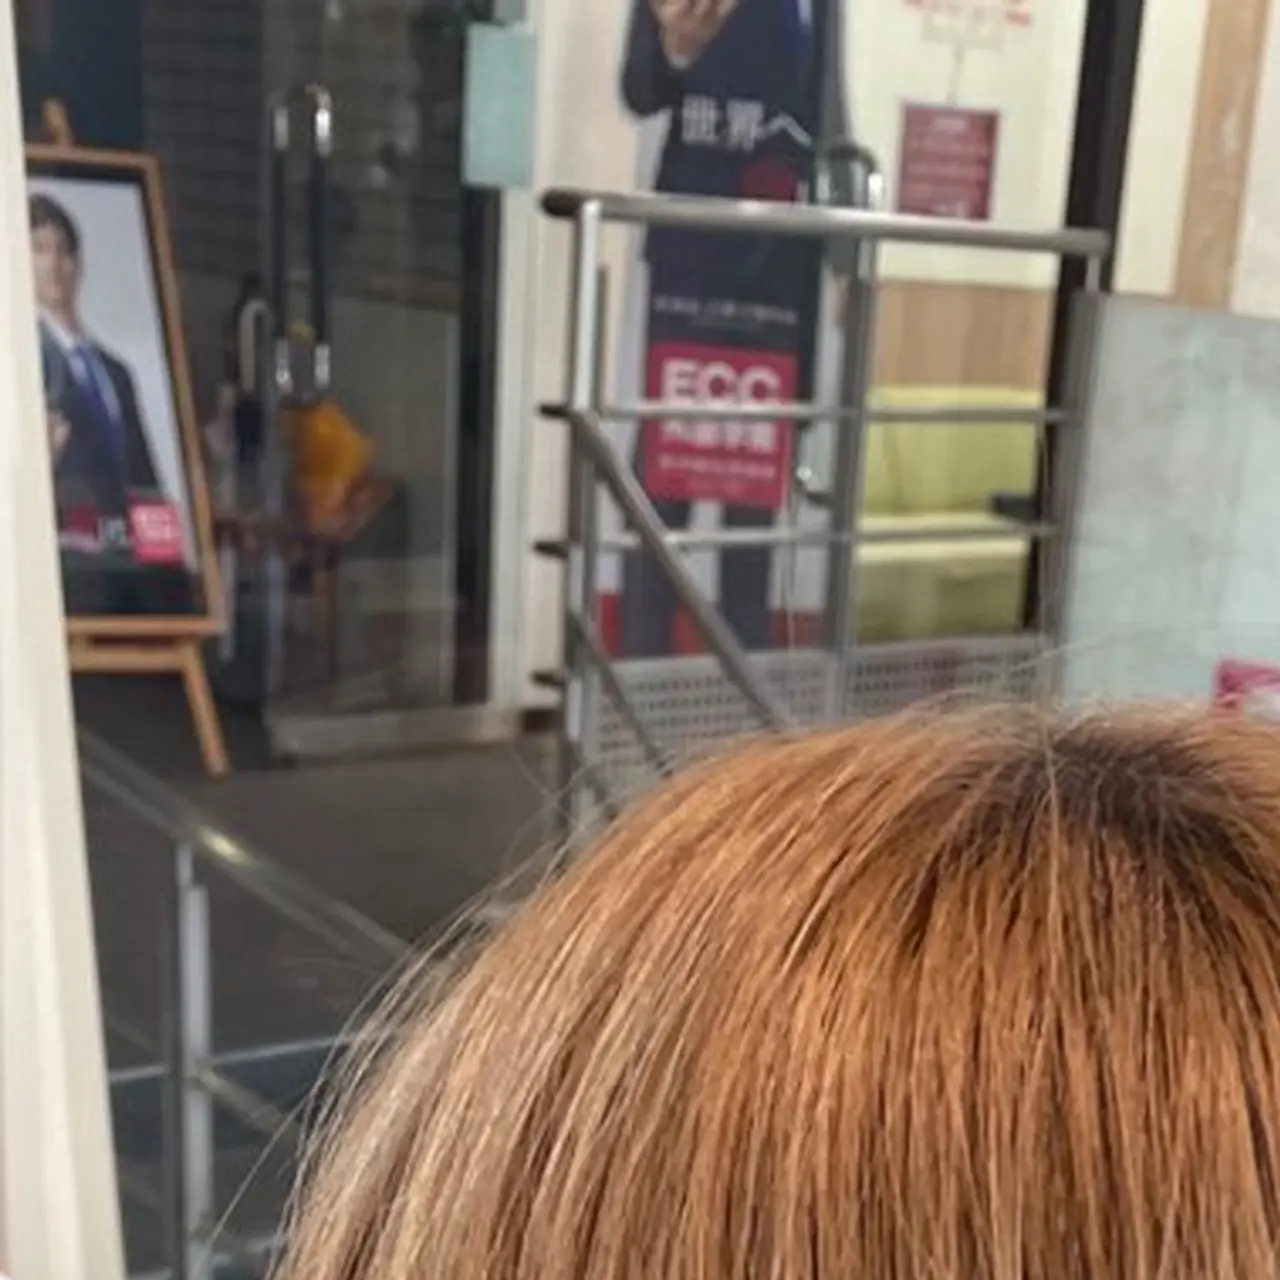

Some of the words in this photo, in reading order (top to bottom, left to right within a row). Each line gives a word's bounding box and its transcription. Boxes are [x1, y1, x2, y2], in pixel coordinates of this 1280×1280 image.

[681, 93, 813, 151] 世界へ
[662, 357, 783, 410] ECC
